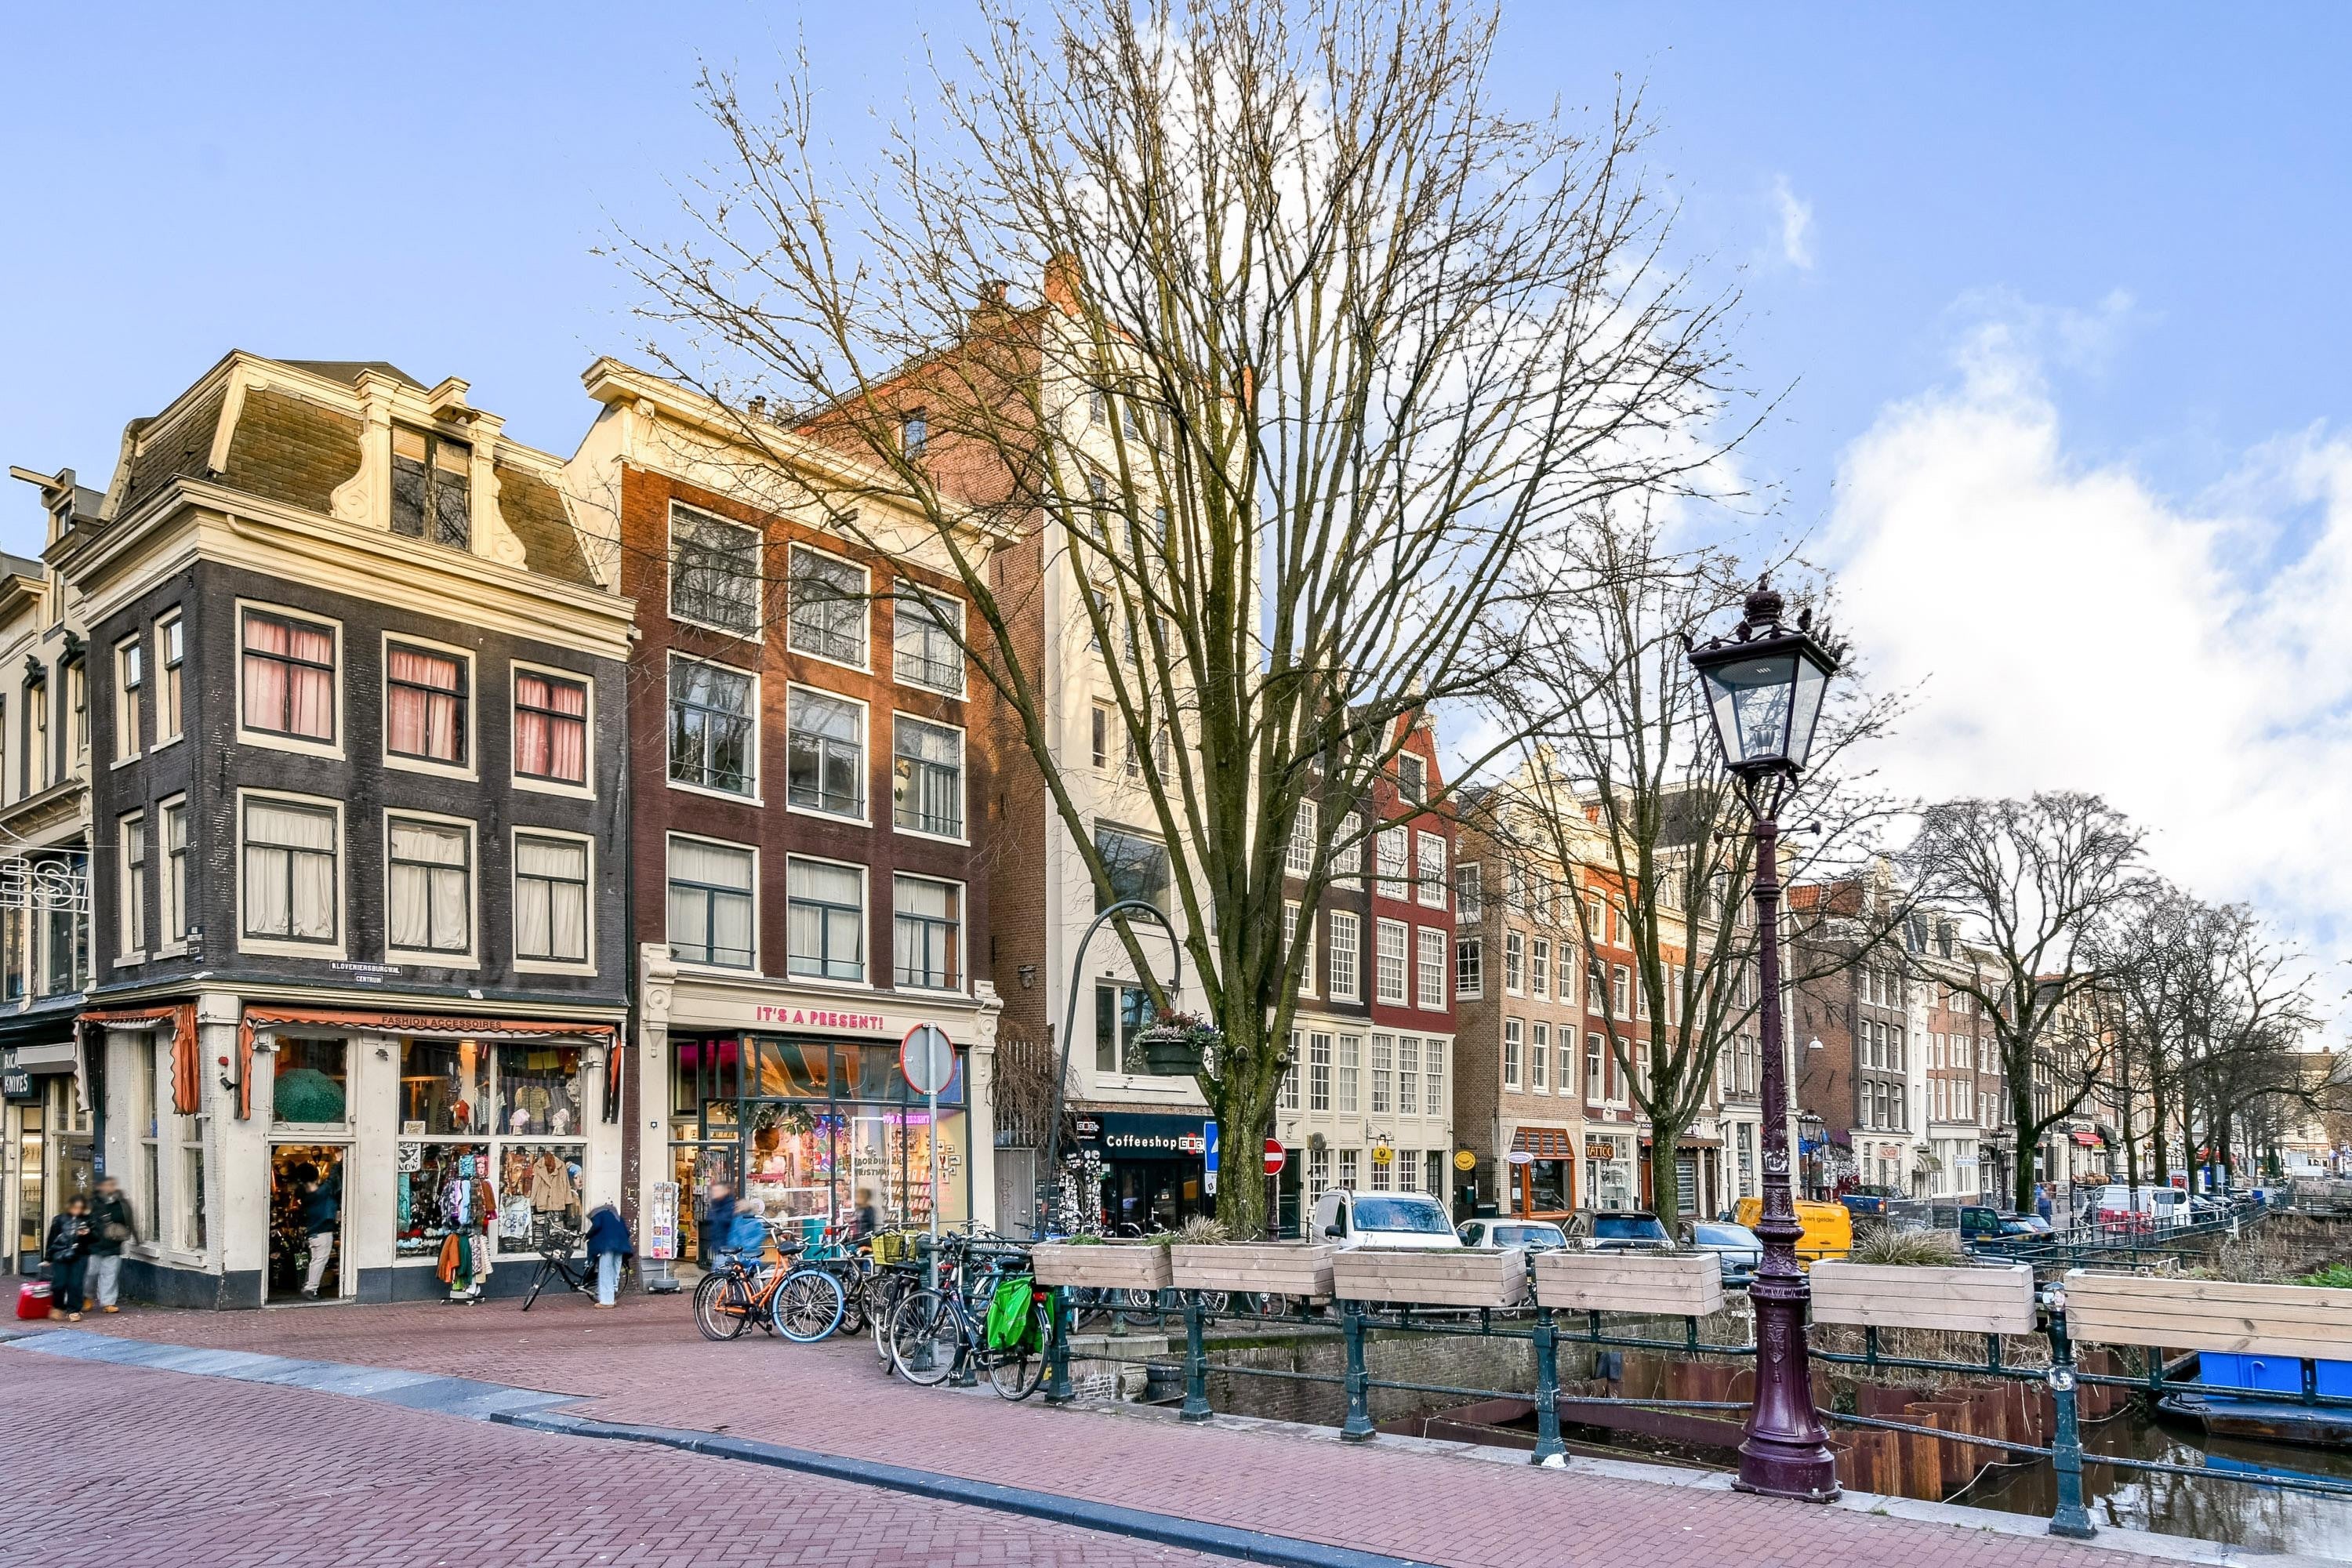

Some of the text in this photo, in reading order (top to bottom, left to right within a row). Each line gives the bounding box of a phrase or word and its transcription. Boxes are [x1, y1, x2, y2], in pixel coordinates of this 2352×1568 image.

[332, 962, 401, 974] KLOVENIERSBURGWAL
[356, 975, 382, 984] CENTRUM
[382, 1015, 502, 1029] FASHION ACCESSOIRES
[757, 1006, 884, 1030] IT'S A PRESENT!
[4, 1073, 28, 1093] KNIVES
[1106, 1134, 1177, 1150] Coffeeshop
[1586, 1145, 1613, 1156] TATTOO
